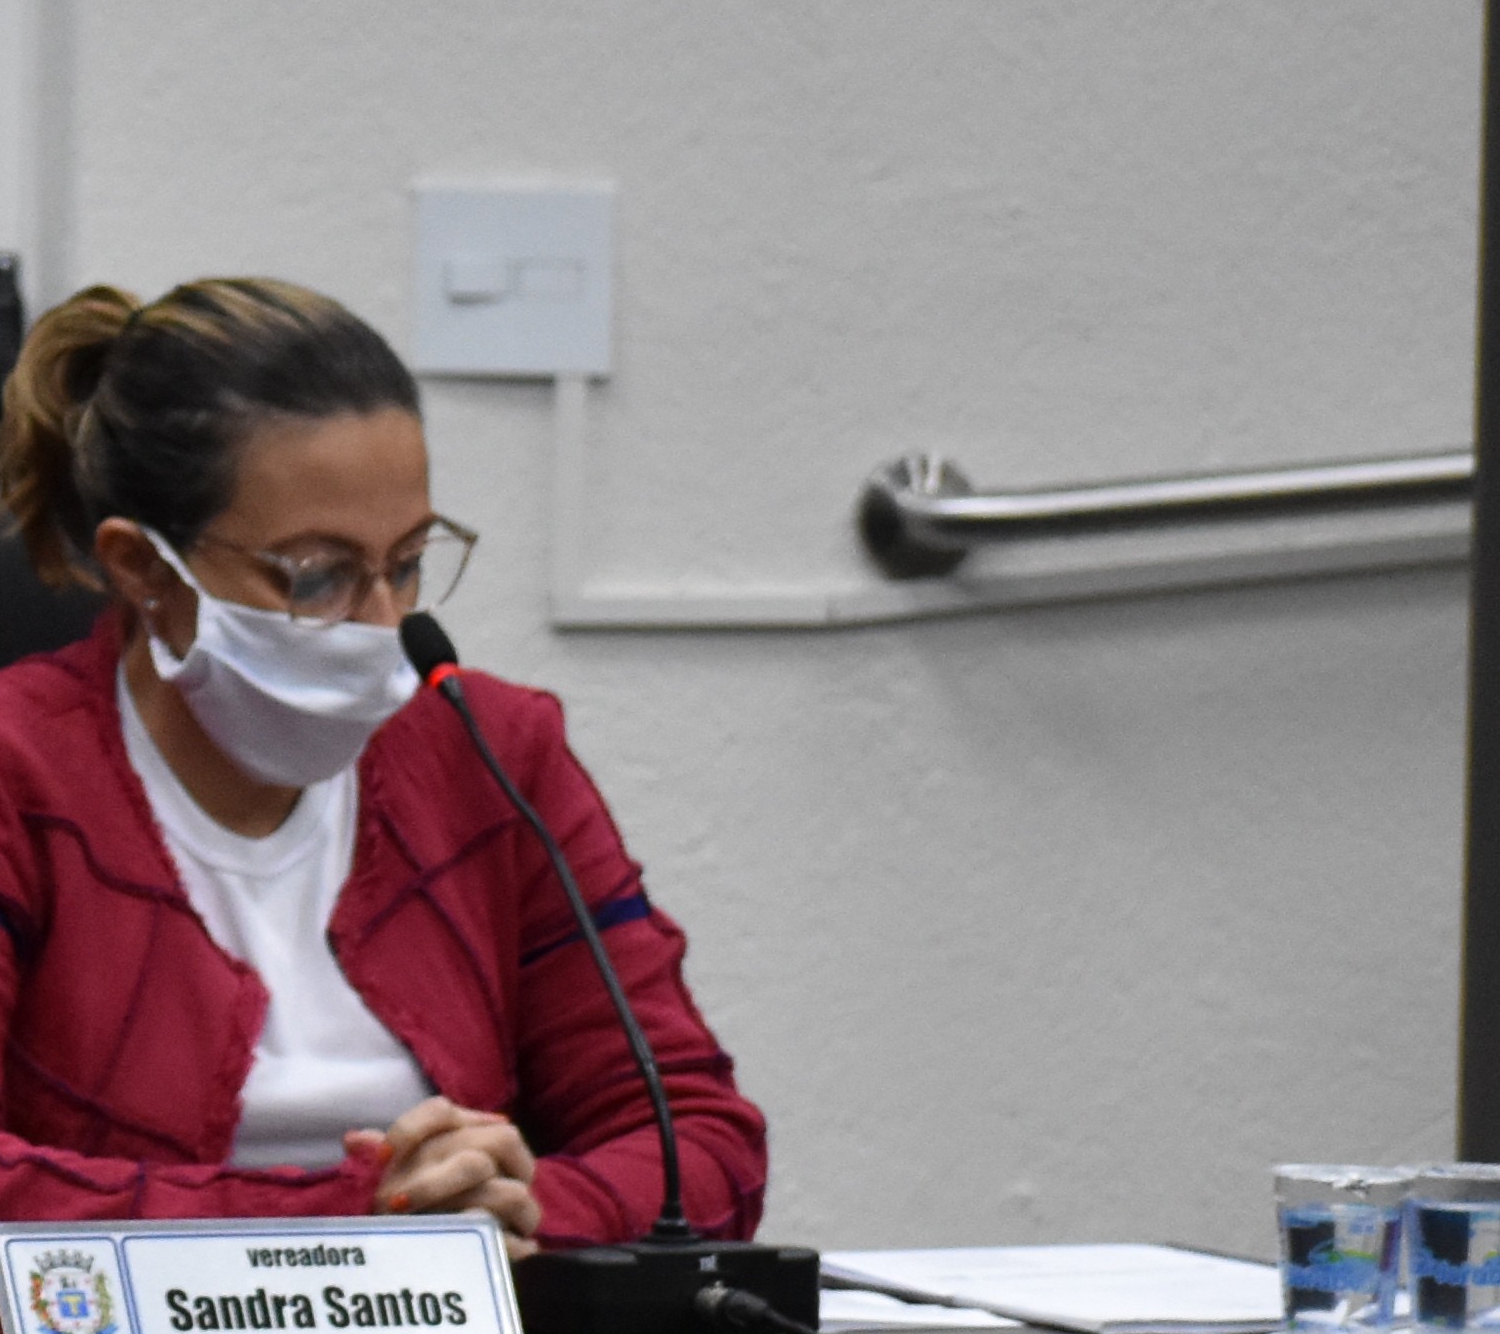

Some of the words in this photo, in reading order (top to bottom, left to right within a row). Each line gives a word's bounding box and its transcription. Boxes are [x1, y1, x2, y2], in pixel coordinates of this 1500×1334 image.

[247, 1243, 367, 1269] vereadora
[166, 1286, 314, 1333] Sandra
[324, 1285, 467, 1331] Santos
